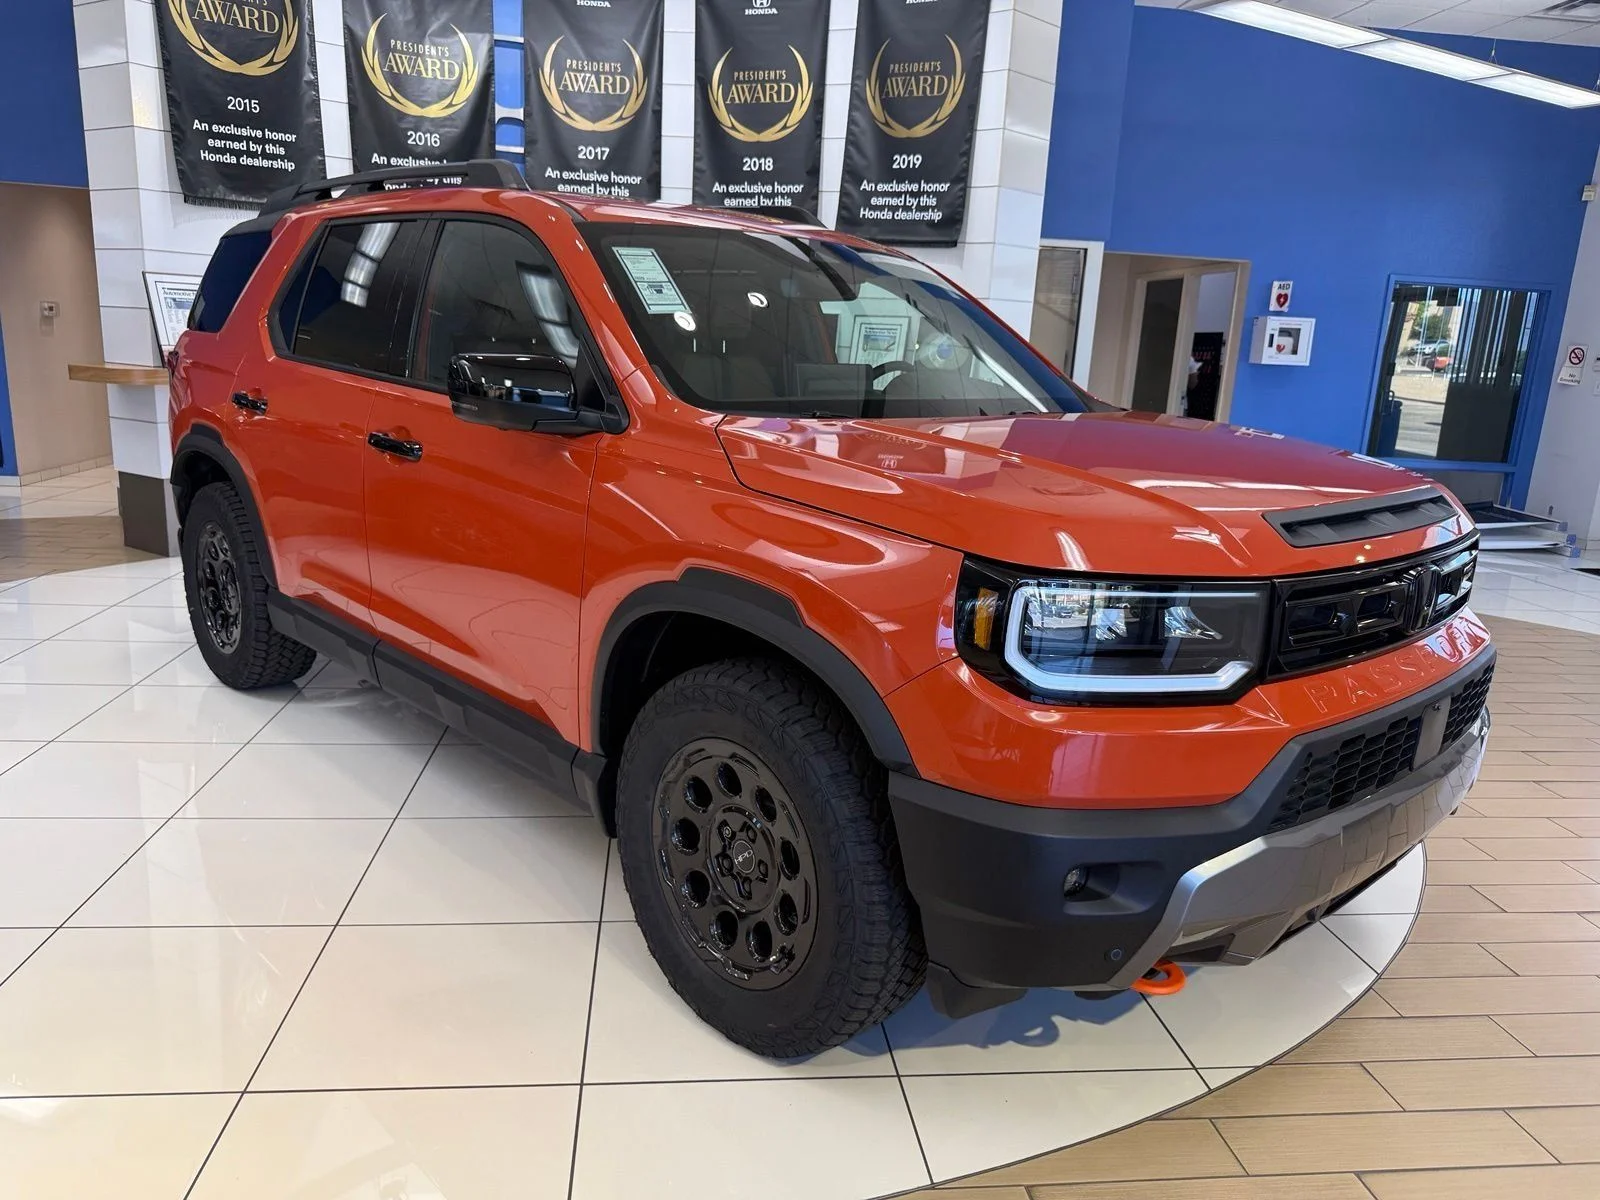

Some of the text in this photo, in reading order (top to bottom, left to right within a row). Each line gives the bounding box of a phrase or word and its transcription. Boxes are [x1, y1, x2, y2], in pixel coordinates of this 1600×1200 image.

[192, 0, 280, 34] AWARD
[390, 39, 450, 57] PRESIDENT'S
[382, 52, 460, 80] AWARD
[566, 59, 622, 73] PRESIDENT'S
[889, 61, 941, 74] PRESIDENT'S
[559, 71, 630, 95] AWARD
[734, 70, 787, 81] PRESIDENT'S
[725, 82, 796, 104] AWARD
[881, 74, 948, 98] AWARD
[227, 96, 260, 113] 2015
[193, 119, 297, 142] An exclusive honor
[208, 138, 285, 155] earned by this
[407, 131, 440, 147] 2016
[371, 152, 387, 165] An
[578, 145, 609, 160] 2017
[200, 149, 295, 172] Honda dealership
[743, 157, 773, 171] 2018
[892, 154, 922, 169] 2019
[545, 166, 642, 185] An exclusive honor
[557, 183, 629, 197] earned by this
[712, 181, 804, 193] An exclusive honor
[860, 179, 950, 192] An exclusive honor
[724, 195, 792, 206] earned by this
[870, 194, 937, 208] earned by this
[860, 206, 942, 223] Honda dealership
[735, 850, 753, 865] HPD
